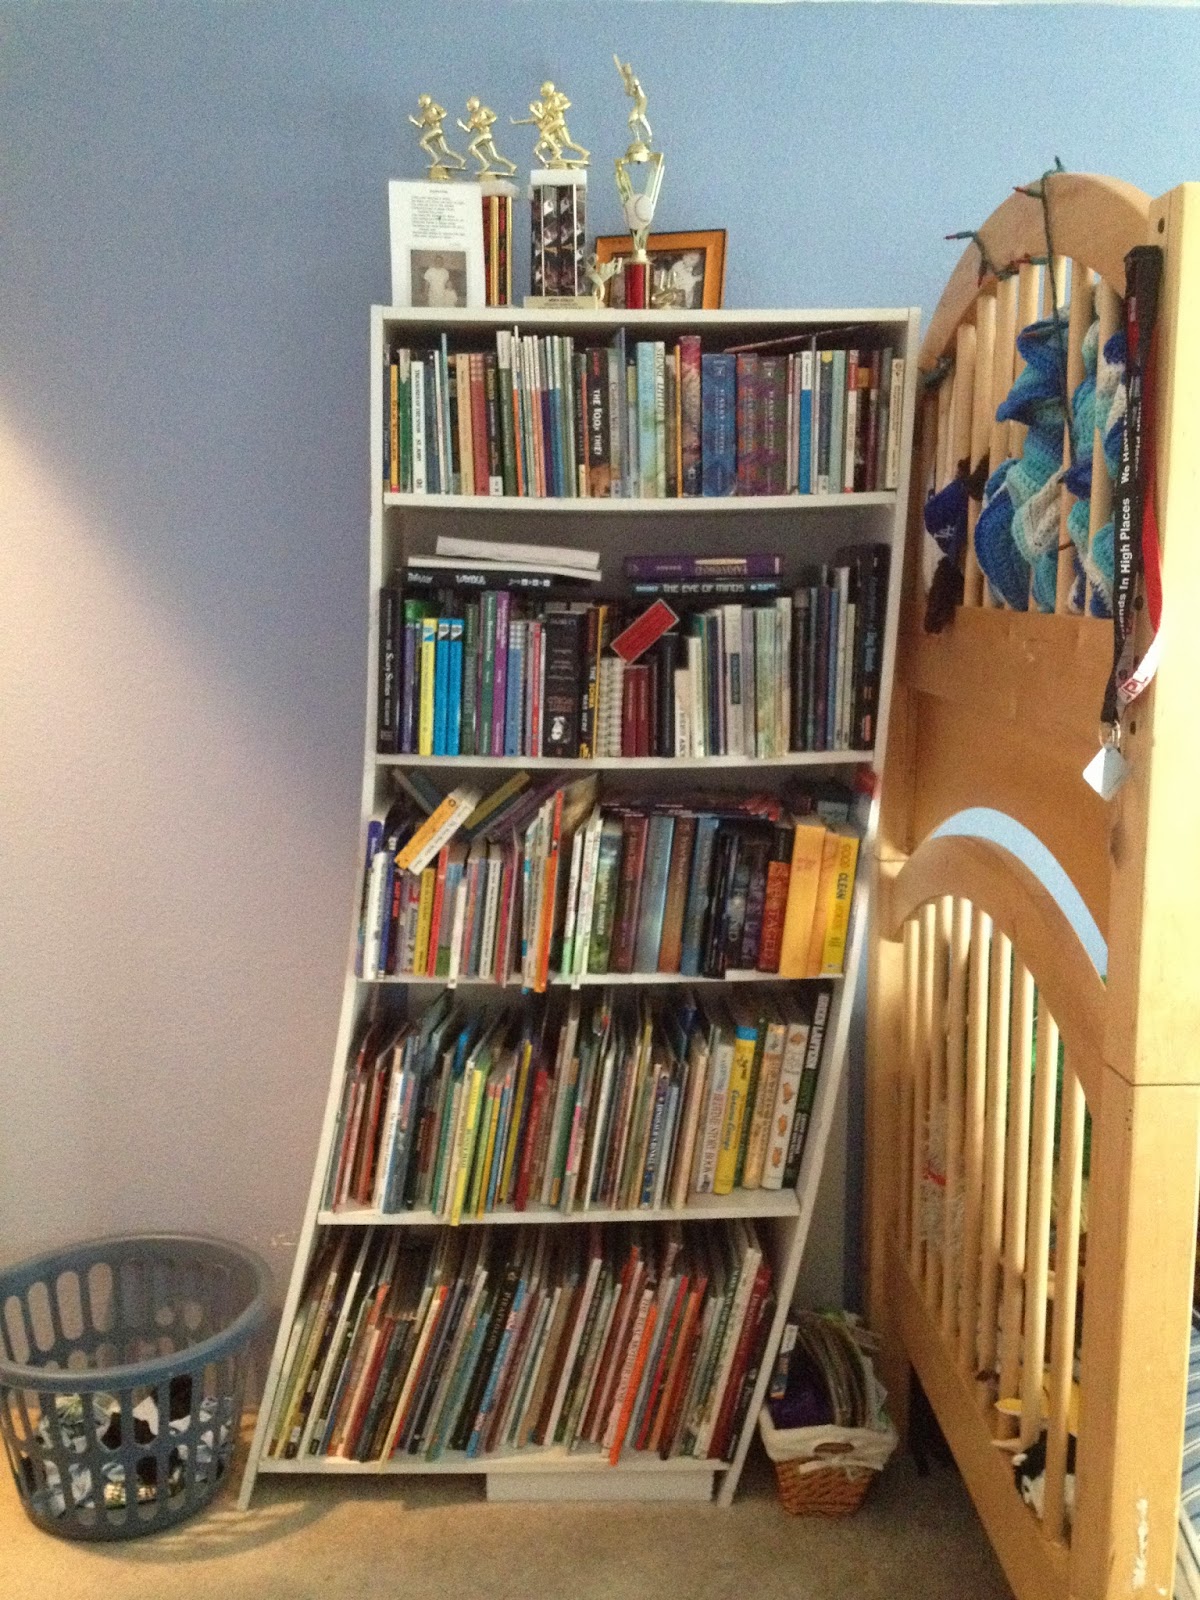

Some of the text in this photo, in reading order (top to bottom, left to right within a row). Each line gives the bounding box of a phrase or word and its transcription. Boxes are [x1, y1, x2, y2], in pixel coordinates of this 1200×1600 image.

[591, 388, 600, 405] THE
[592, 407, 603, 430] BOOK
[1121, 464, 1131, 485] We
[1116, 497, 1132, 639] iends In High Places
[662, 584, 678, 592] THE
[681, 584, 698, 592] EYE
[700, 584, 712, 592] OF
[835, 871, 849, 900] CLEAN
